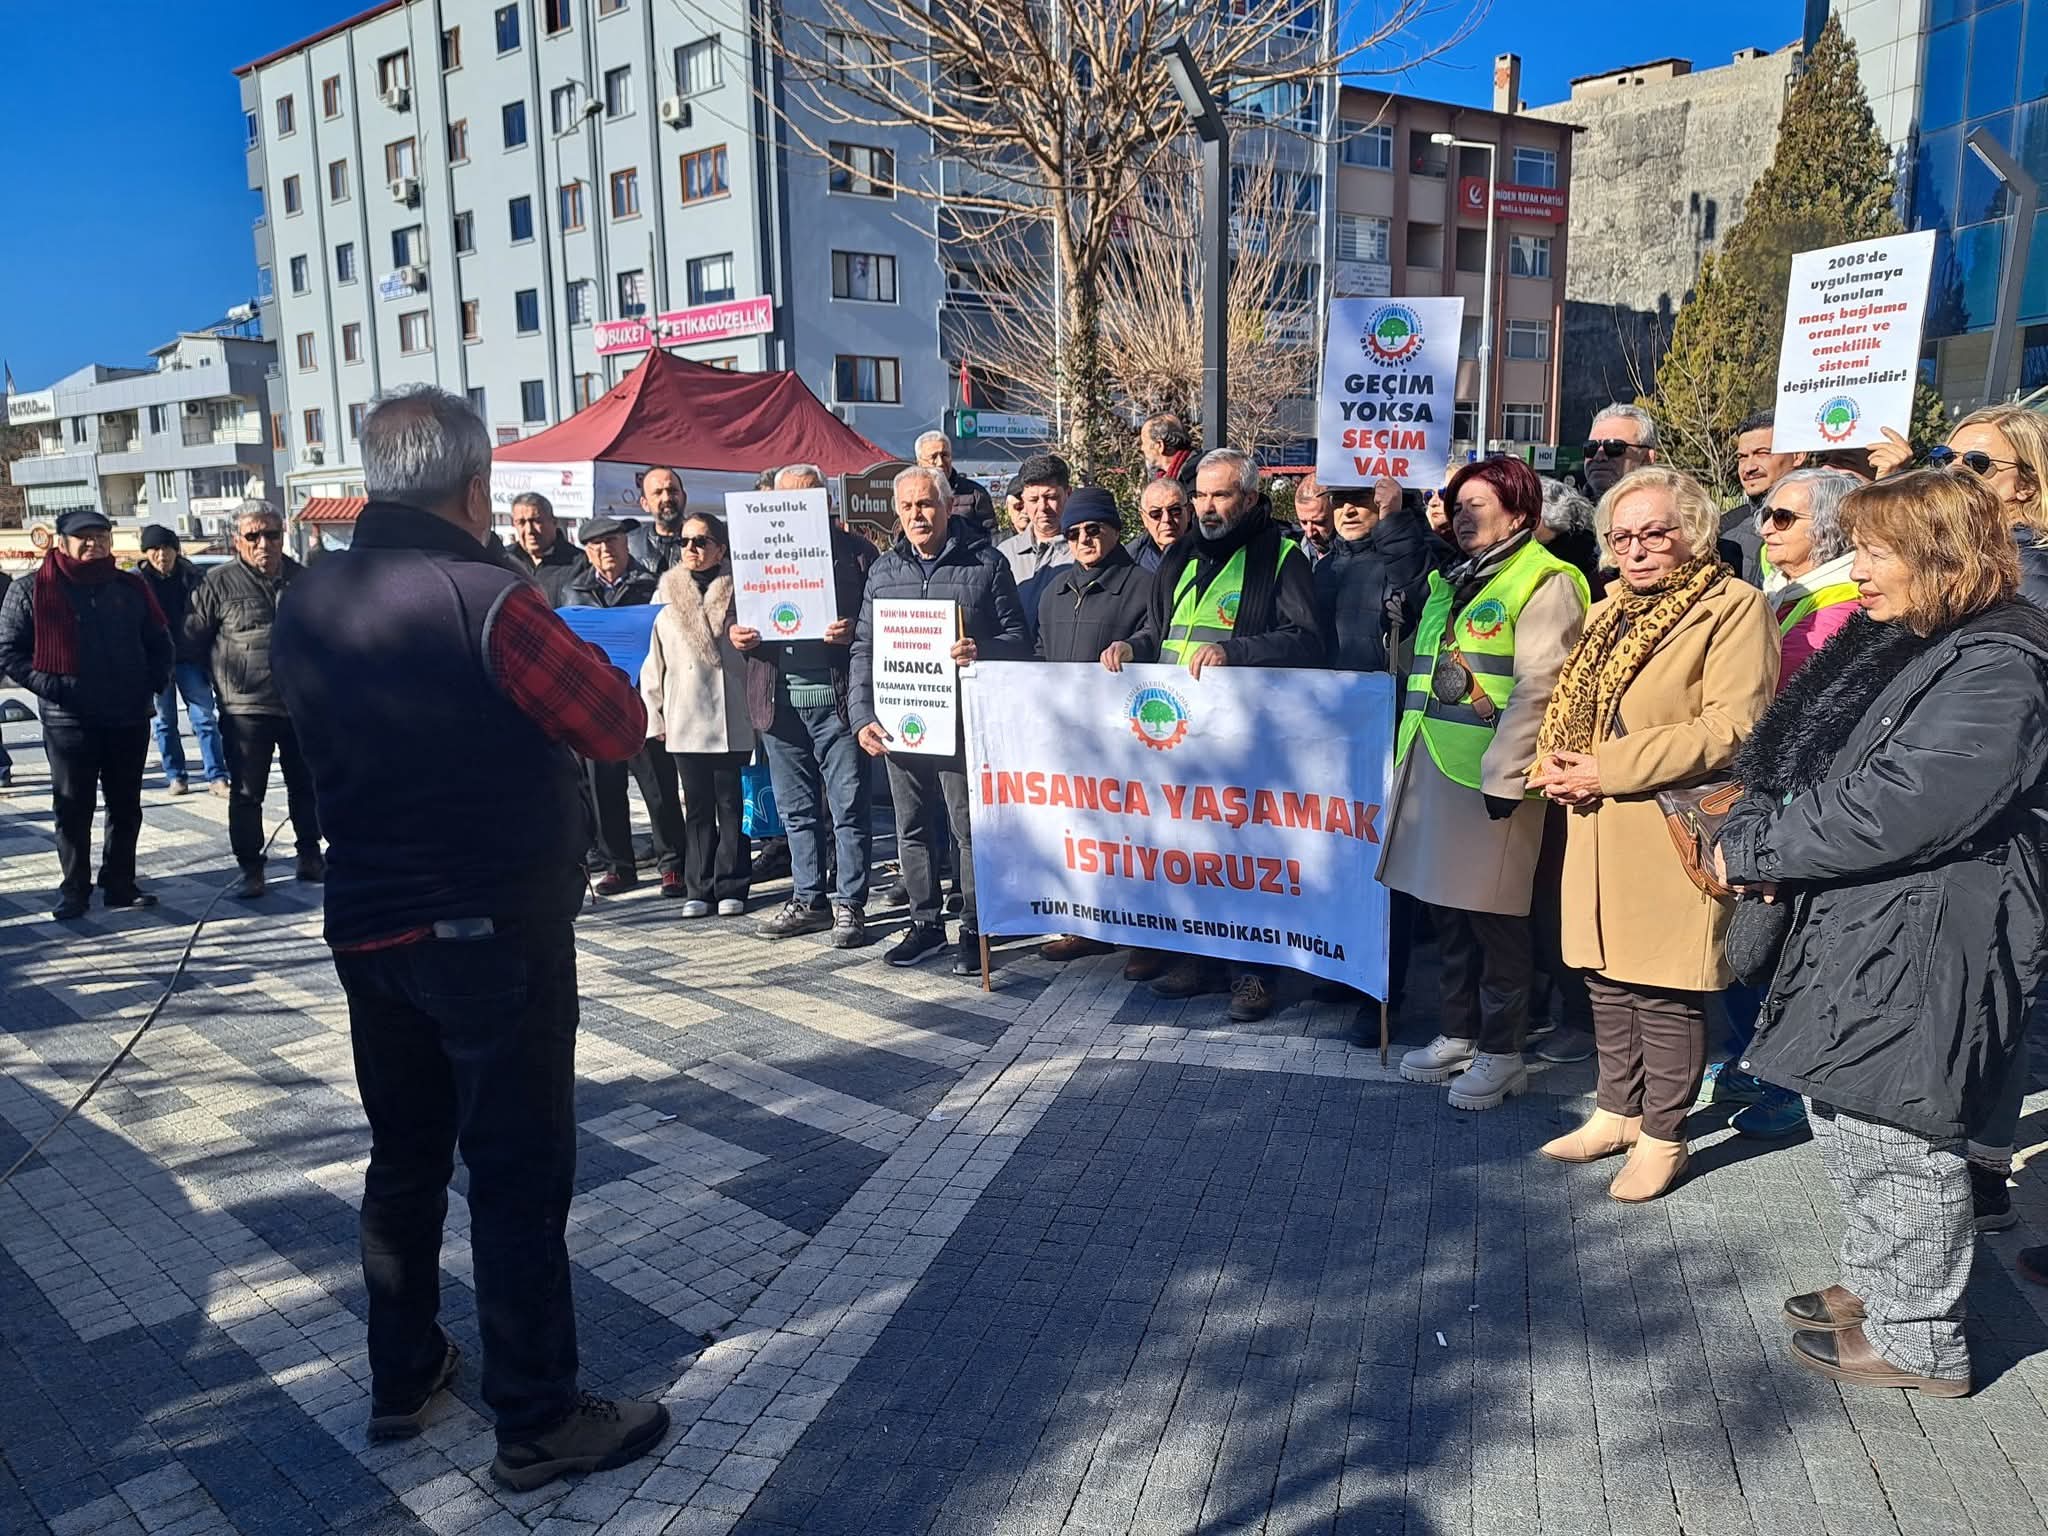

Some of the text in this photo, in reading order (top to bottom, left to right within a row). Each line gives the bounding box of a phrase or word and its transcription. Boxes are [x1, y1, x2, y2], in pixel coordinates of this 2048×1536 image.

[1828, 251, 1888, 270] 2008'de
[1810, 266, 1904, 291] uygulamaya
[1823, 286, 1884, 305] konulan
[1799, 301, 1908, 326] maaş bağlama
[1808, 320, 1891, 341] oranları ve
[1812, 338, 1882, 357] emeklilik
[1818, 356, 1870, 373] sistemi
[1344, 368, 1434, 400] GEÇİM
[1783, 369, 1908, 394] değiştirilmelidir!
[1339, 401, 1433, 423] YOKSA
[1341, 424, 1426, 455] SEÇİM
[1538, 451, 1553, 460] HDI
[1353, 456, 1410, 478] VAR
[745, 501, 808, 514] Yoksulluk
[851, 493, 888, 513] Orhan
[770, 520, 785, 528] ve
[764, 533, 794, 547] açlık
[733, 547, 830, 561] kader değildir.
[764, 564, 800, 576] Katıl,
[743, 578, 825, 593] değiştirelim!
[883, 625, 943, 636] MAAŞLARIMIZI
[884, 656, 944, 674] İNSANCA
[876, 681, 952, 693] YAŞAMAYA YETECEK
[879, 695, 949, 708] ÜCRET İSTİYORUZ.
[981, 763, 1381, 845] İNSANCA YAŞAMAK
[1063, 828, 1302, 898] İSTİYORUZ!
[1030, 896, 1346, 962] TÜM EMEKLİLERİN SENDİKASI MUĞLA
